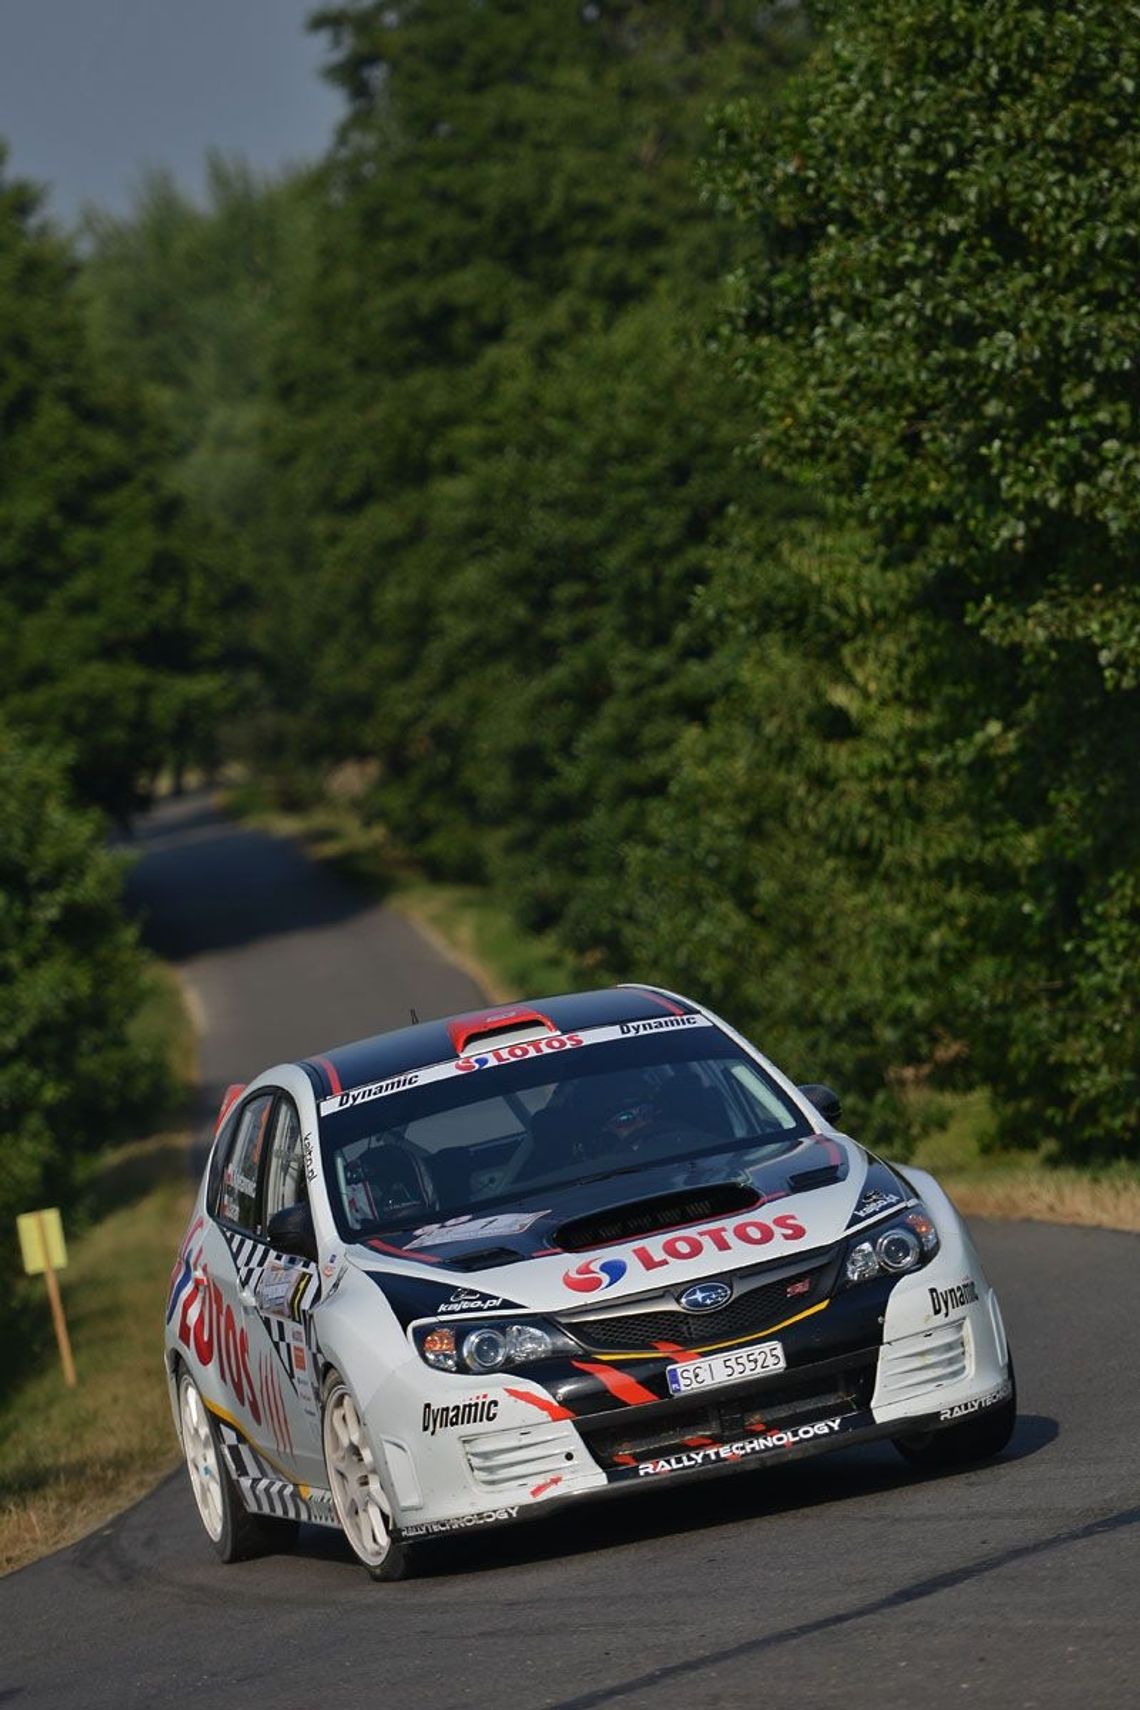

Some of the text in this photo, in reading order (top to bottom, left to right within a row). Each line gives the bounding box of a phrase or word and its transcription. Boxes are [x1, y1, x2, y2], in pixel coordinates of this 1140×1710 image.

[618, 1015, 697, 1035] Dynamic
[494, 1033, 584, 1062] LOTOS
[338, 1073, 420, 1107] Dynamic
[632, 1214, 807, 1271] LOTOS
[437, 1297, 503, 1313] kajto.pl
[178, 1264, 263, 1427] LOTOS
[681, 1347, 781, 1387] SCI 55525
[422, 1399, 499, 1436] Dynamic
[638, 1418, 842, 1476] RALLYTECHNOLOGY
[401, 1506, 519, 1538] RALLYTECHNOLOGY
